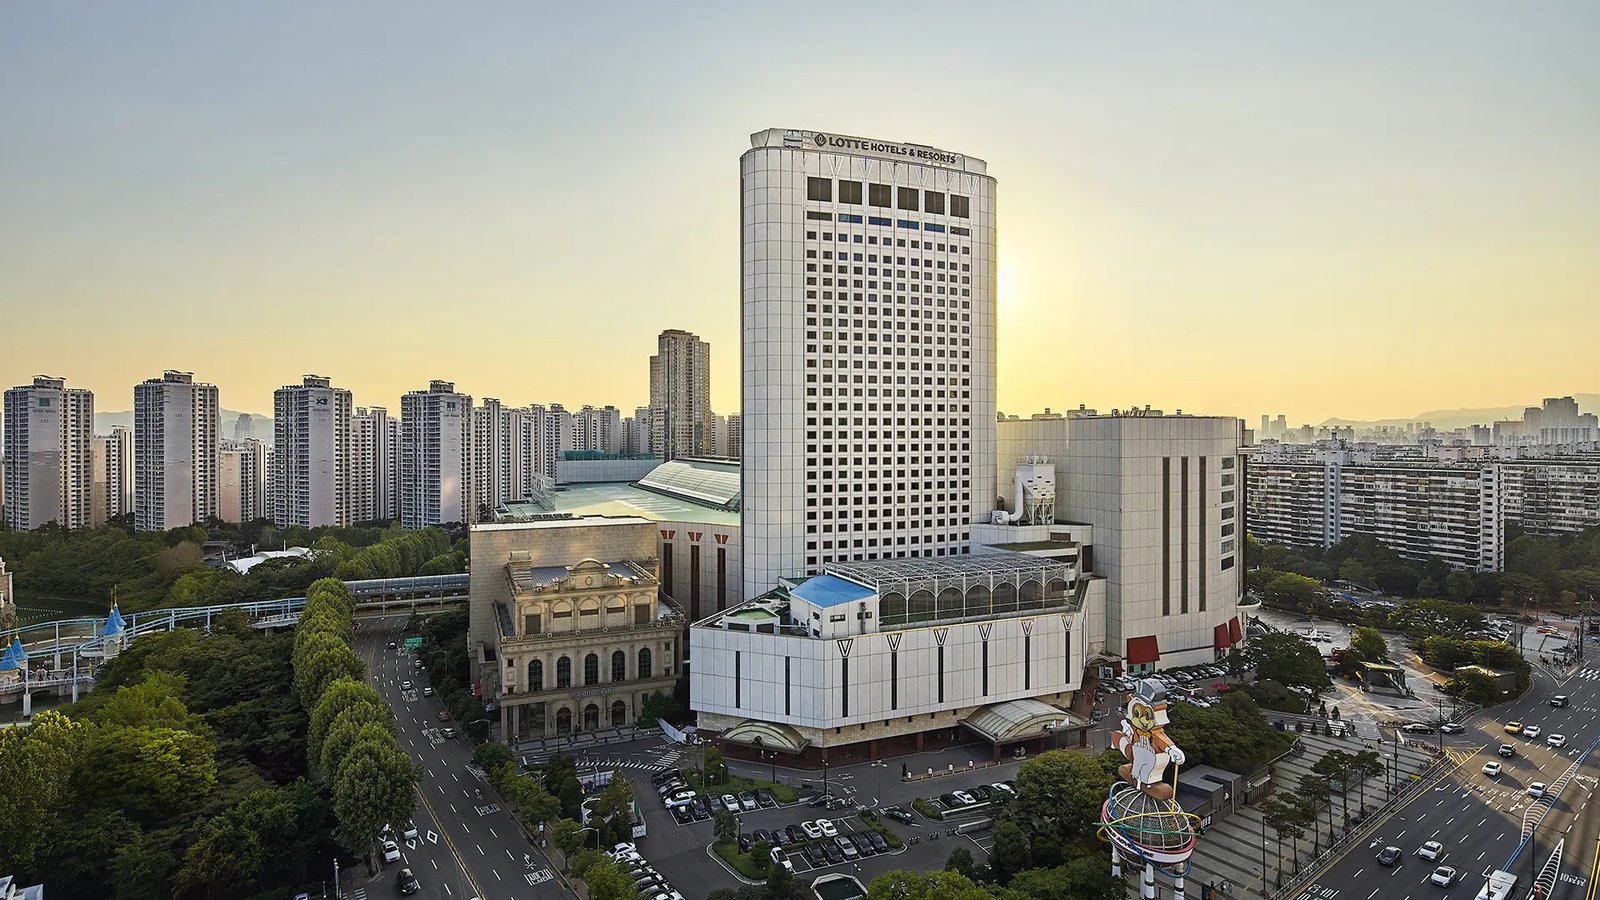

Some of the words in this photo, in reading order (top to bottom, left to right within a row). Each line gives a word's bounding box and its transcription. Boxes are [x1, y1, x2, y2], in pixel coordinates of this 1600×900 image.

[828, 136, 869, 151] LOTTE
[870, 142, 907, 156] HOTELS
[908, 148, 915, 157] &
[917, 149, 957, 164] RESORTS
